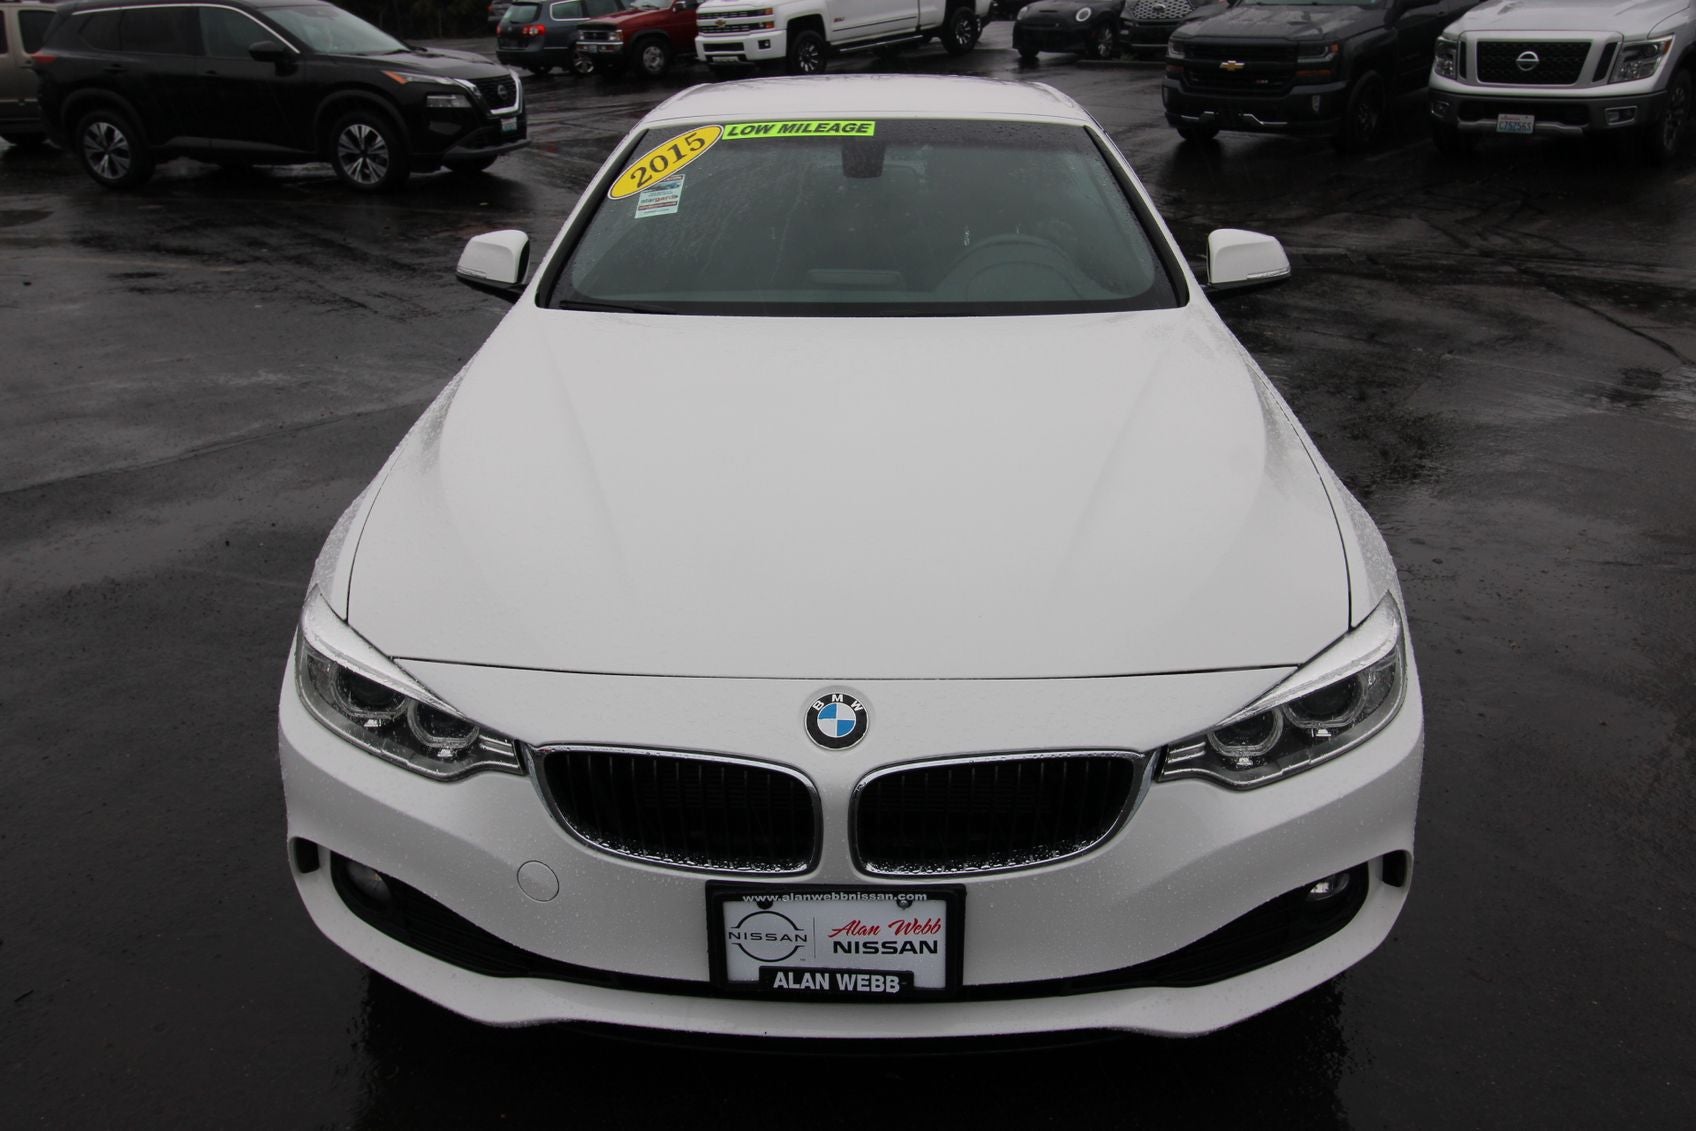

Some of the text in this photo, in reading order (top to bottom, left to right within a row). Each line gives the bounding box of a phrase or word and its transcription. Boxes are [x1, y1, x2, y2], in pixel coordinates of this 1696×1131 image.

[726, 122, 872, 137] LOW MILEAGE
[630, 132, 706, 188] 2015
[811, 694, 863, 711] BMW
[743, 892, 928, 903] www.alanwebbnissan.com
[827, 917, 942, 938] Alan Webb
[728, 930, 808, 943] NISSAN
[833, 940, 938, 955] NISSAN
[773, 972, 900, 993] ALAN WEBB
